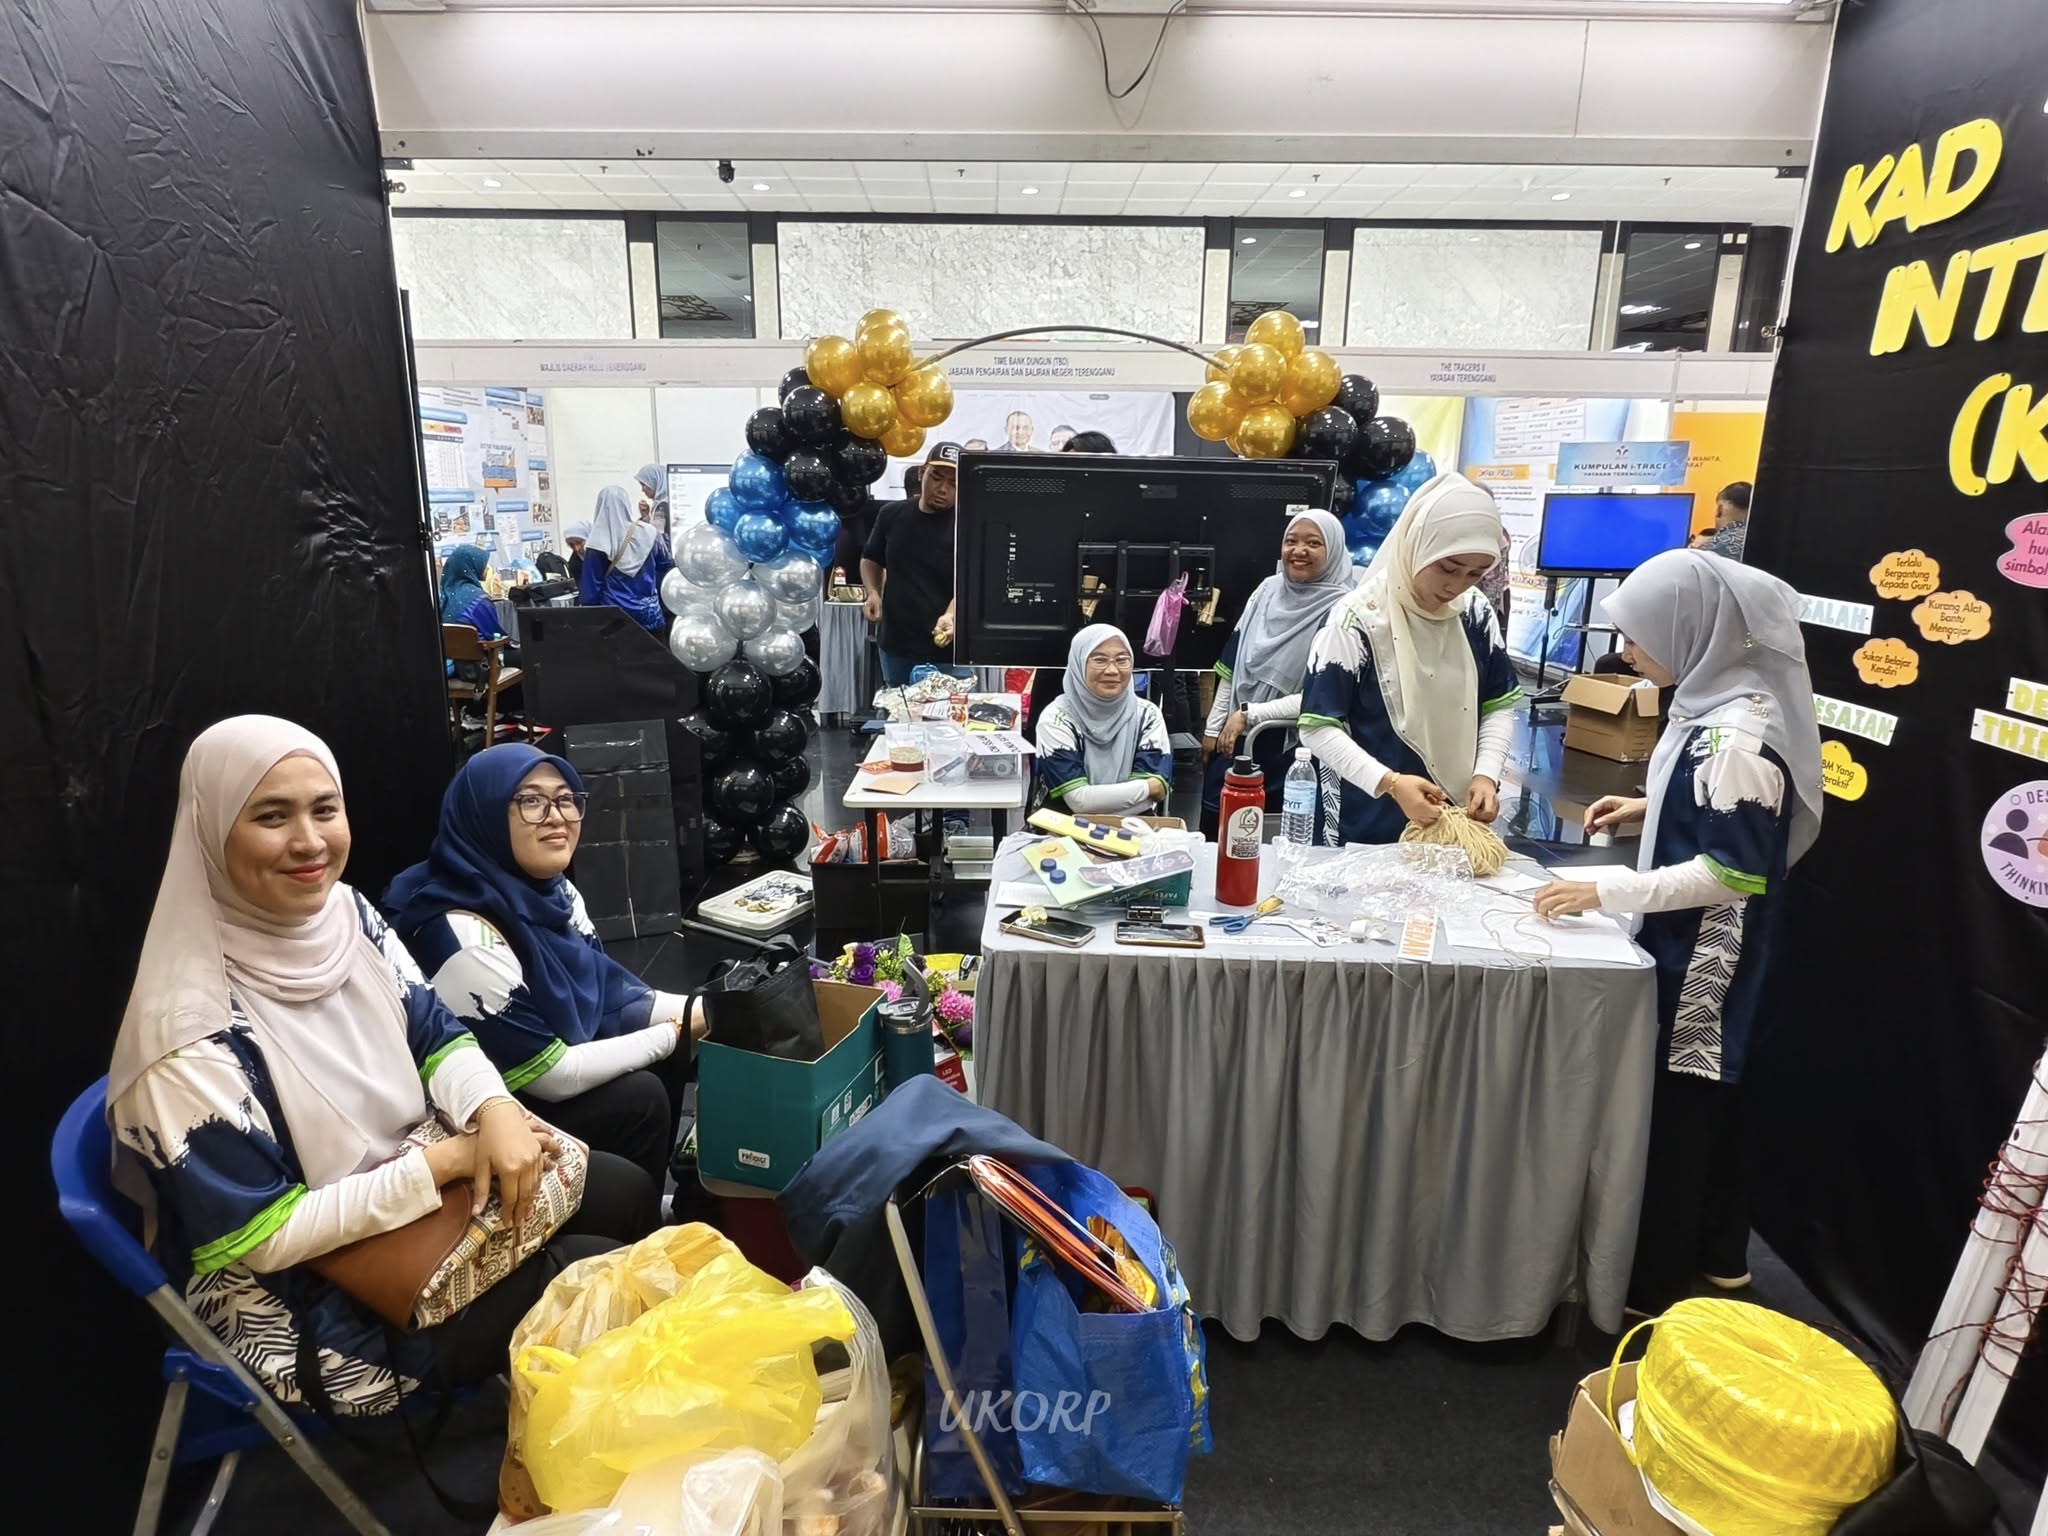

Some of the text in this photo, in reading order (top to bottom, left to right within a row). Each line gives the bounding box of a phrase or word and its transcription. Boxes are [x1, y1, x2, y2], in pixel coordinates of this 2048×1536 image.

[1825, 117, 2003, 253] KAD
[1009, 356, 1025, 366] BANK
[1011, 368, 1024, 377] DAN
[1896, 557, 1922, 567] Terlalu
[1884, 568, 1930, 581] Bergantung
[1879, 579, 1933, 591] Kepada Guru
[1928, 599, 1983, 614] Kurang Alat
[1940, 612, 1966, 623] Bantu
[1928, 622, 1972, 637] Mengajar
[1861, 650, 1913, 670] Sukar Belajar
[1836, 763, 1855, 781] Yang
